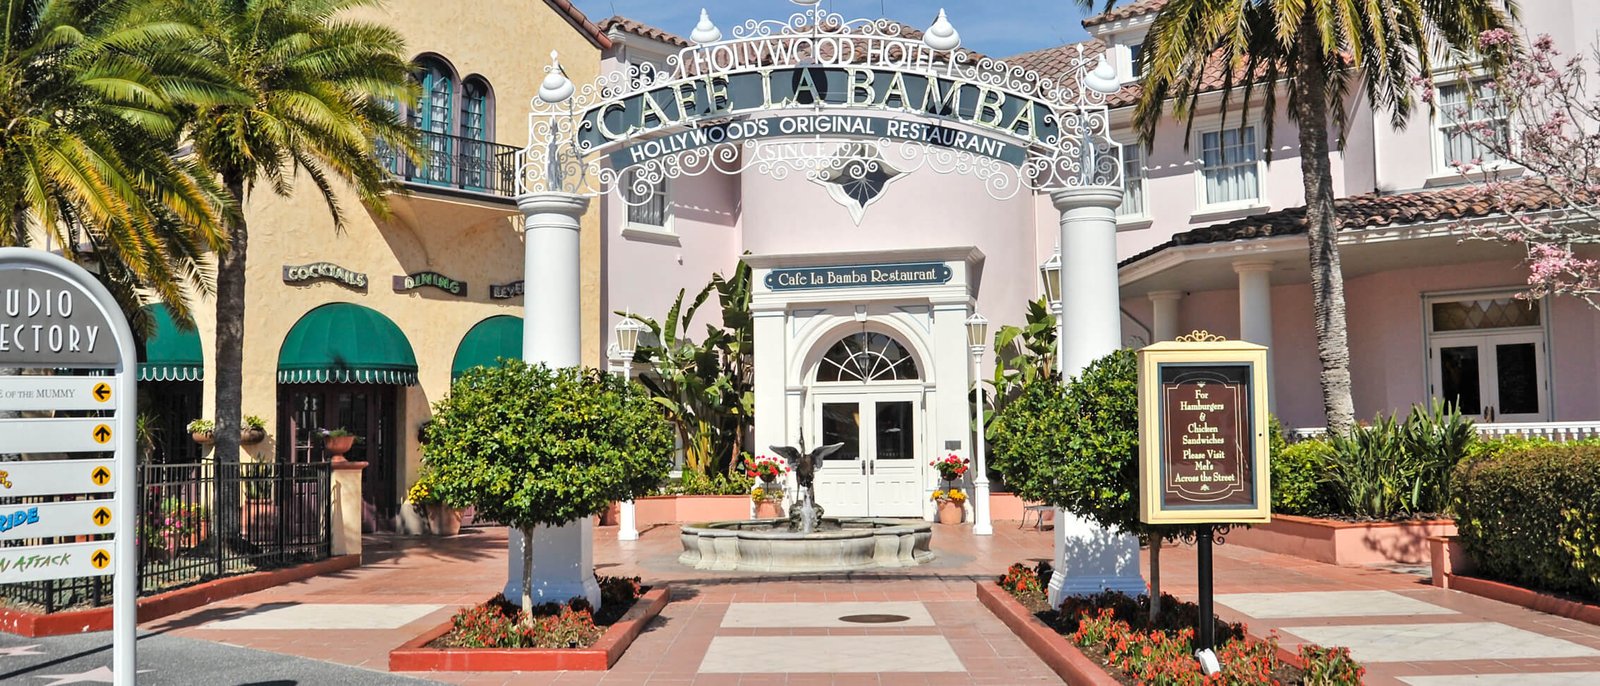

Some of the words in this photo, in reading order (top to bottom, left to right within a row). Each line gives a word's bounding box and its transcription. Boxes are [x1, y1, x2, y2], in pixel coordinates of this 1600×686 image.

[693, 37, 855, 77] HOLLYWOOD
[867, 38, 937, 74] HOTEL
[597, 74, 734, 141] CAFE
[757, 67, 821, 109] LA
[846, 67, 1039, 142] BAMBA
[630, 118, 769, 163] HOLLYWOOD'S
[779, 115, 875, 135] ORIGINAL
[887, 120, 1006, 158] RESTAURANT
[765, 142, 828, 160] SINCE
[288, 263, 367, 287] COCKTAILS
[404, 272, 461, 293] DINING
[778, 272, 807, 286] Cafe
[810, 272, 824, 285] La
[827, 270, 867, 284] Bamba
[870, 268, 937, 283] Restaurant
[5, 390, 17, 399] OF
[17, 390, 35, 399] THE
[36, 388, 76, 399] MUMMY
[1195, 389, 1209, 399] For
[1180, 400, 1224, 412] Hamburgers
[1199, 412, 1206, 421] &
[1187, 422, 1219, 433] Chicken
[1182, 434, 1225, 445] Sandwiches
[1182, 448, 1205, 459] Please
[1207, 449, 1225, 459] Visit
[1195, 460, 1214, 471] Mel's
[1175, 473, 1199, 482] Across
[1200, 471, 1212, 482] the
[1213, 471, 1235, 482] Street
[0, 506, 40, 533] RIDE
[12, 553, 72, 572] ATTACK
